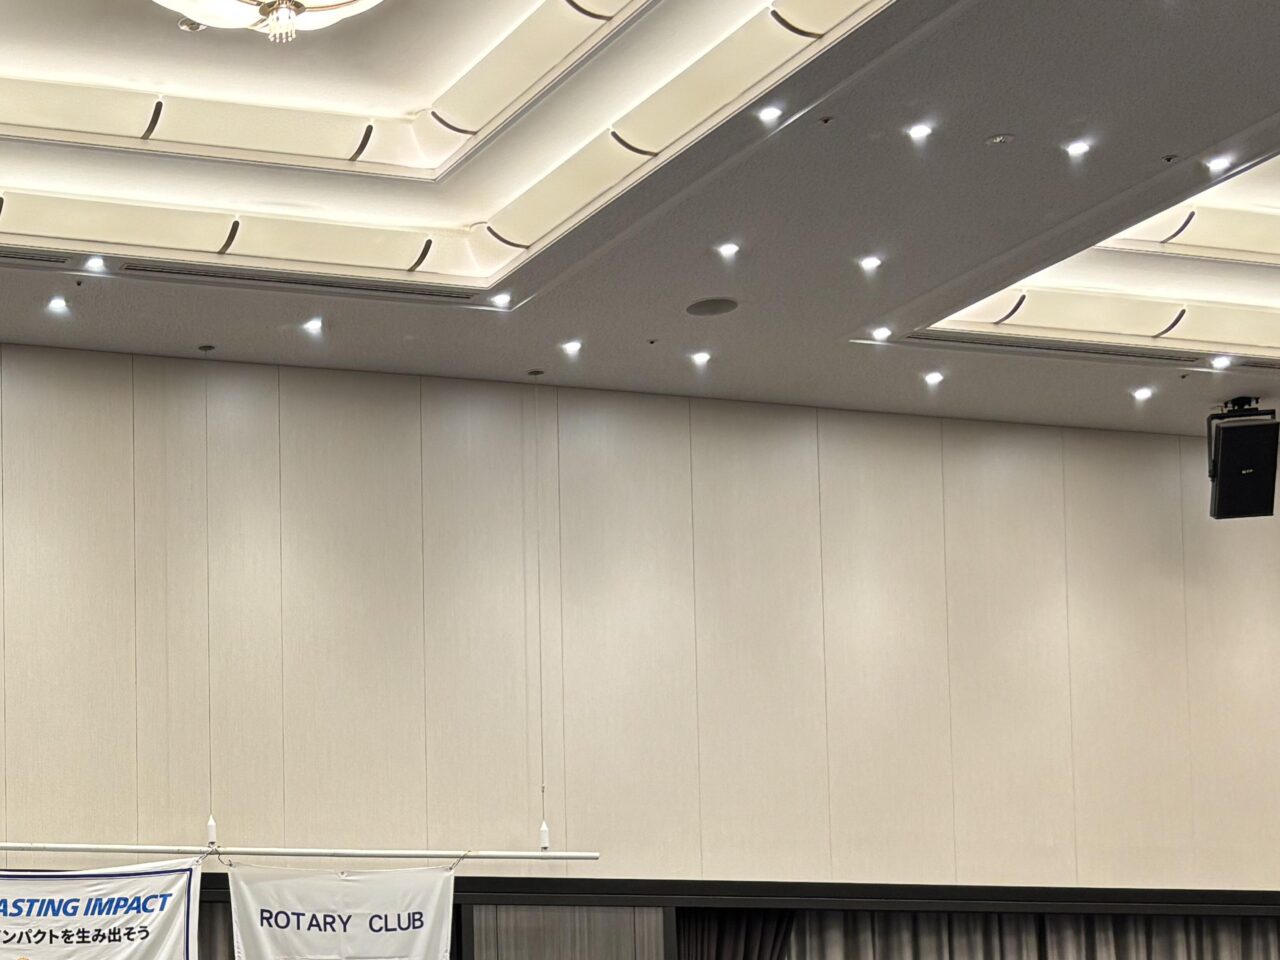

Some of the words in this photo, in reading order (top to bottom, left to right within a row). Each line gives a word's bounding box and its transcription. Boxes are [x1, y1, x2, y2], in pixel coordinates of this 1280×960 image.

[83, 893, 172, 916] IMPACT
[260, 908, 352, 933] ROTARY
[369, 911, 424, 933] CLUB
